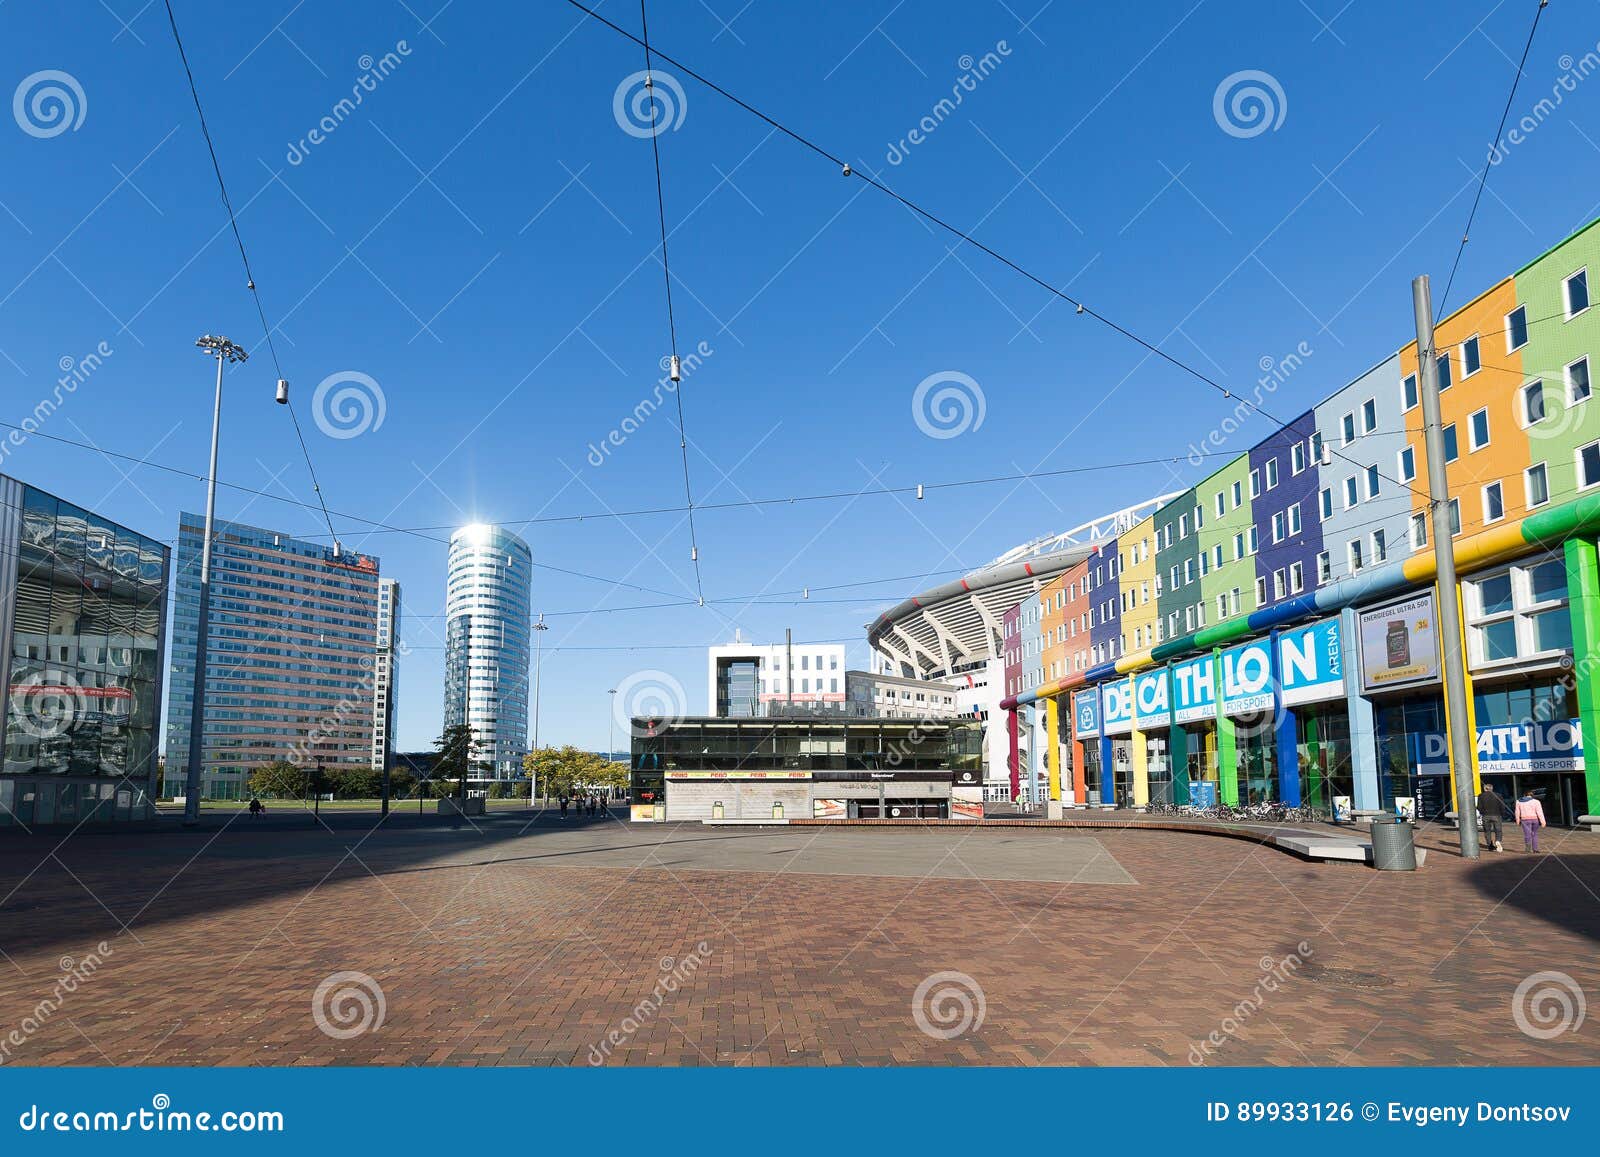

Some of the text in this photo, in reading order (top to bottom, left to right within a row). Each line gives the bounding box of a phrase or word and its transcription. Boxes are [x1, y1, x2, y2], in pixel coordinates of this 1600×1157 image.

[1327, 625, 1339, 676] ARENA
[1226, 700, 1242, 712] FOR
[1244, 694, 1272, 709] SPORT
[1510, 762, 1527, 770] ALL
[1528, 761, 1546, 769] FOR
[1548, 759, 1578, 769] SPORT
